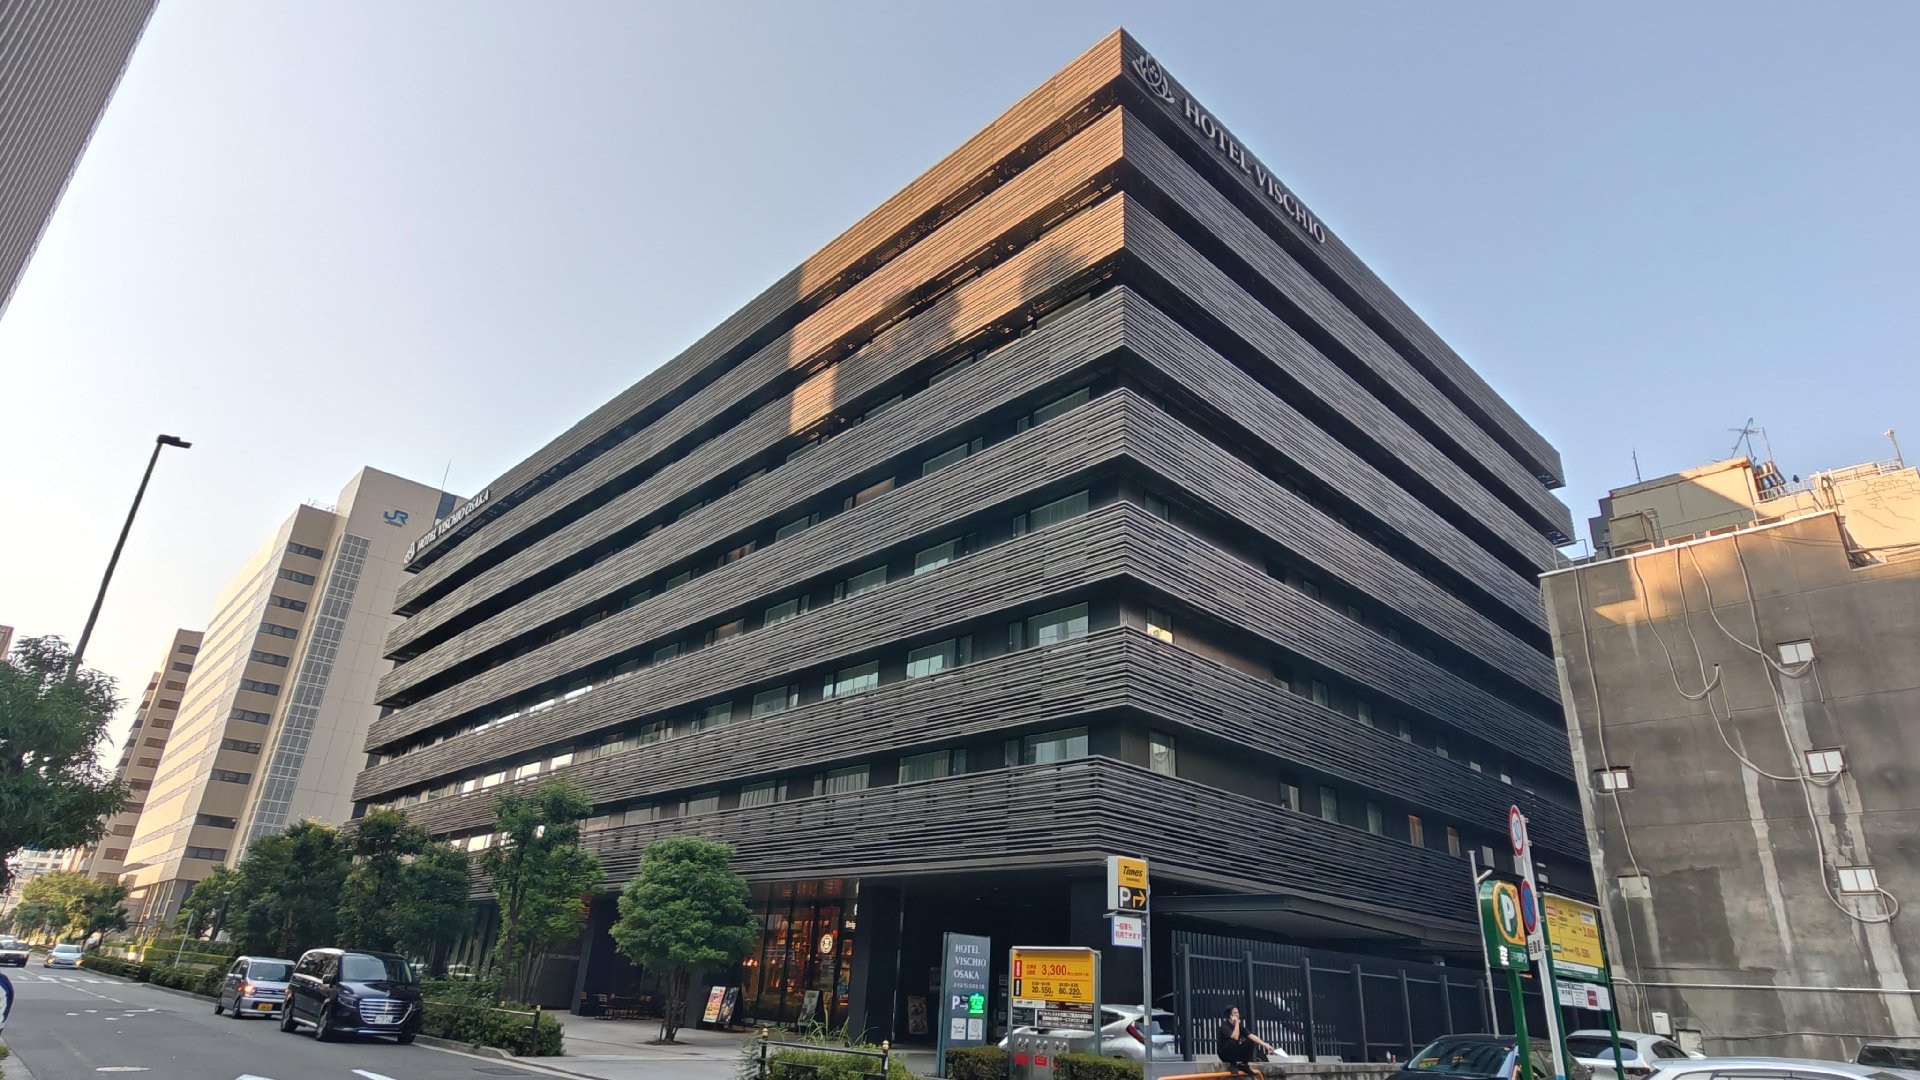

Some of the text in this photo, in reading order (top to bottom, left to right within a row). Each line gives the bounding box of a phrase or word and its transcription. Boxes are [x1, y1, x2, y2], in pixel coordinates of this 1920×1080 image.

[1184, 97, 1326, 244] HOTEL VISCHIO
[383, 509, 409, 527] JR
[1123, 865, 1143, 878] Times
[1120, 886, 1131, 907] P
[1500, 893, 1515, 932] P
[955, 943, 980, 954] HOTEL
[955, 956, 986, 967] VISCHIO
[953, 969, 980, 980] OSAKA
[1041, 964, 1067, 977] 3,300
[951, 995, 960, 1010] P
[969, 993, 985, 1013] 空
